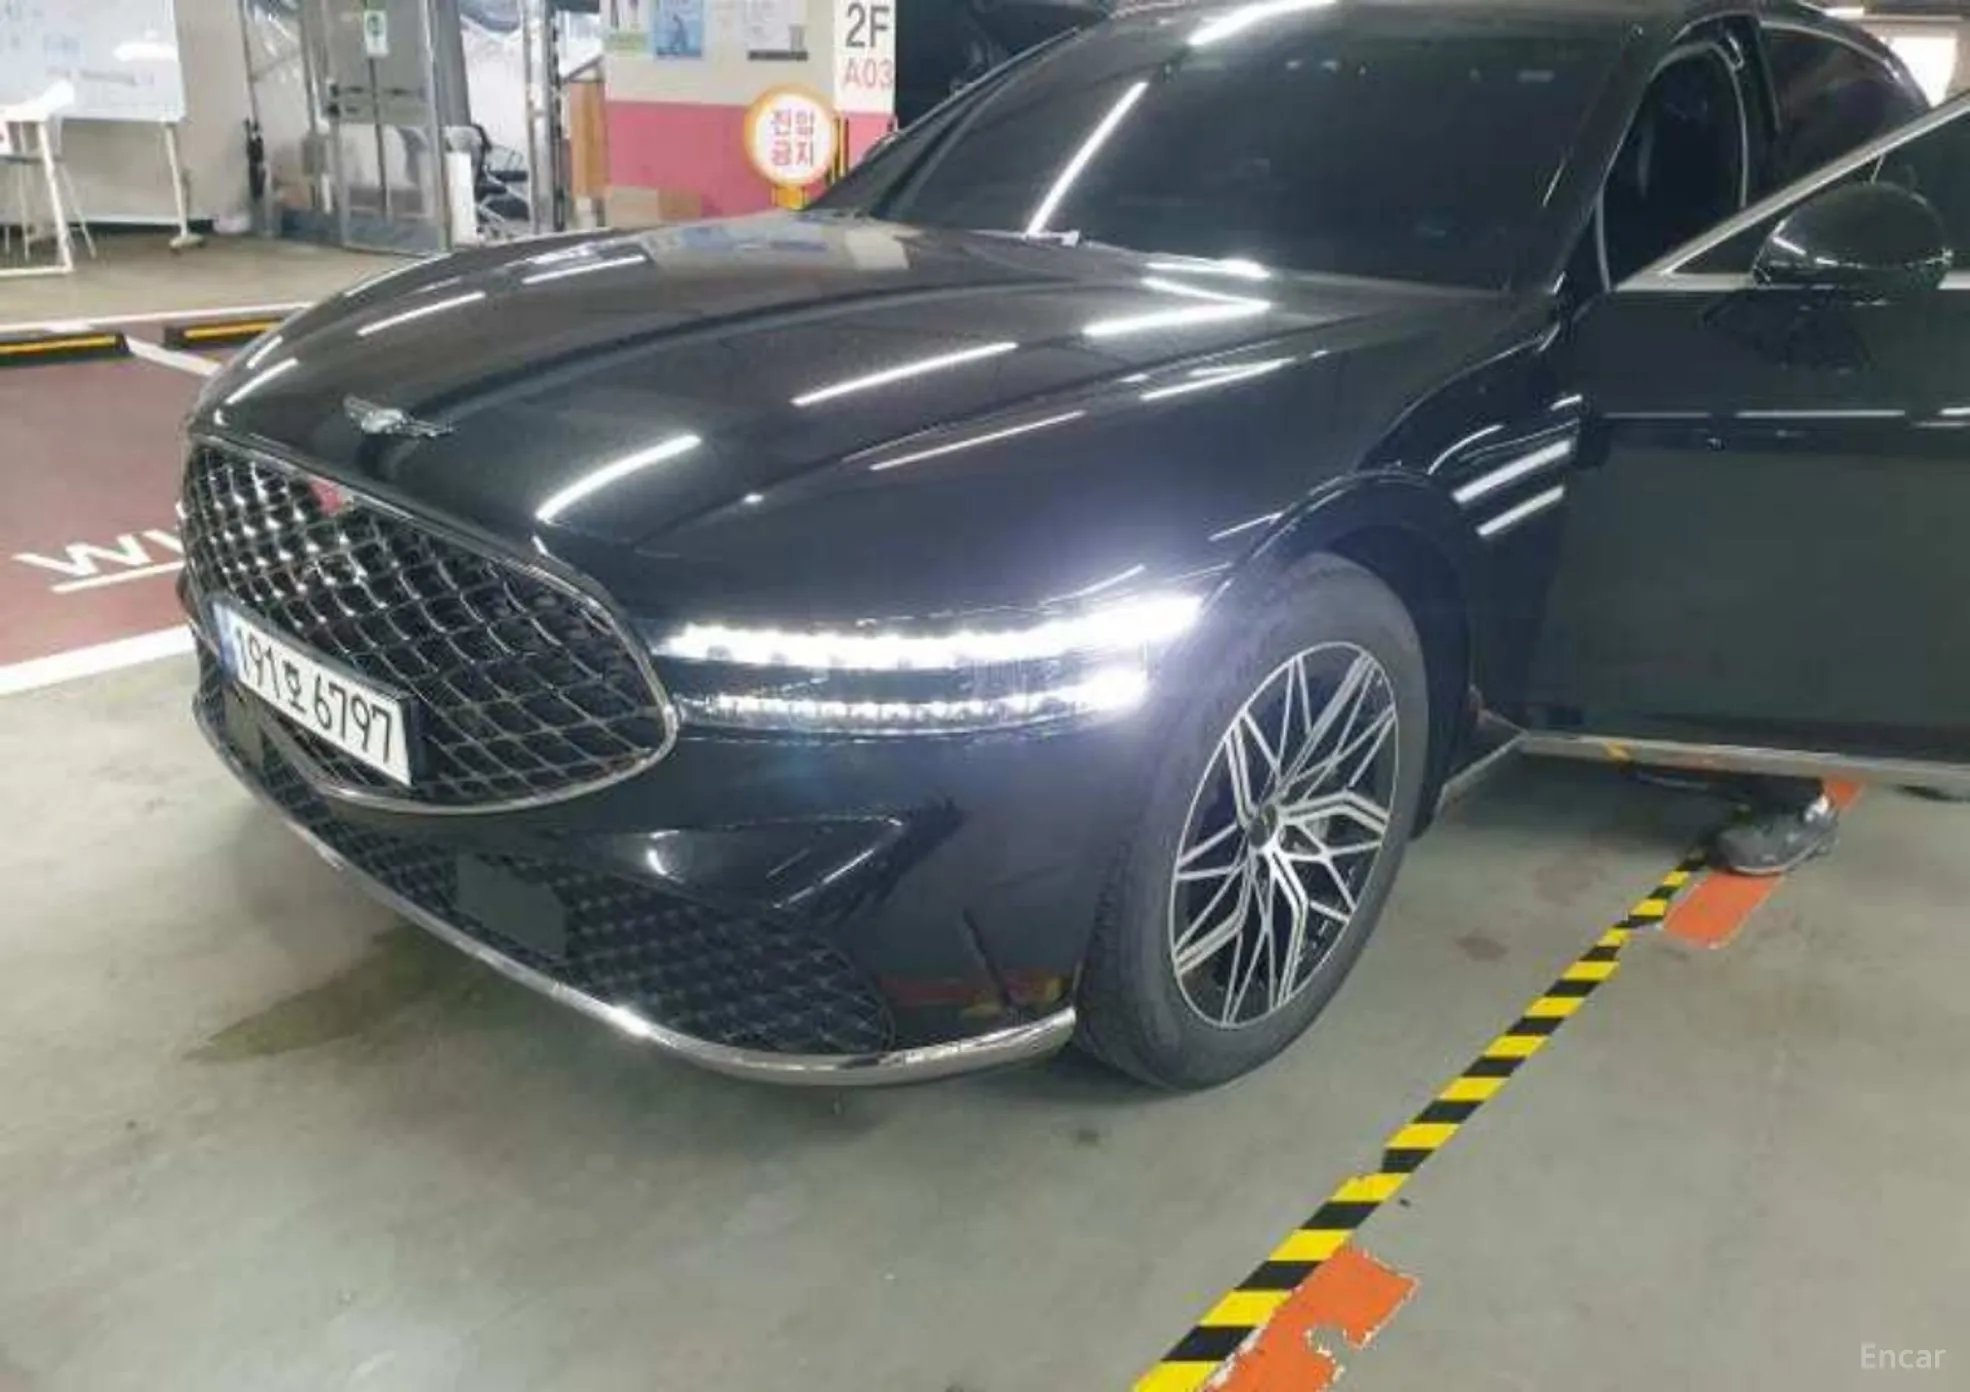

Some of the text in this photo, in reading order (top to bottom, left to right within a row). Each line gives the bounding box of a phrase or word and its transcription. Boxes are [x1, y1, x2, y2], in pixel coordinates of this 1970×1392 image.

[846, 2, 890, 48] 2F
[843, 57, 894, 91] A03
[771, 108, 815, 135] 진입
[771, 139, 815, 167] 금지
[314, 671, 393, 764] 6797
